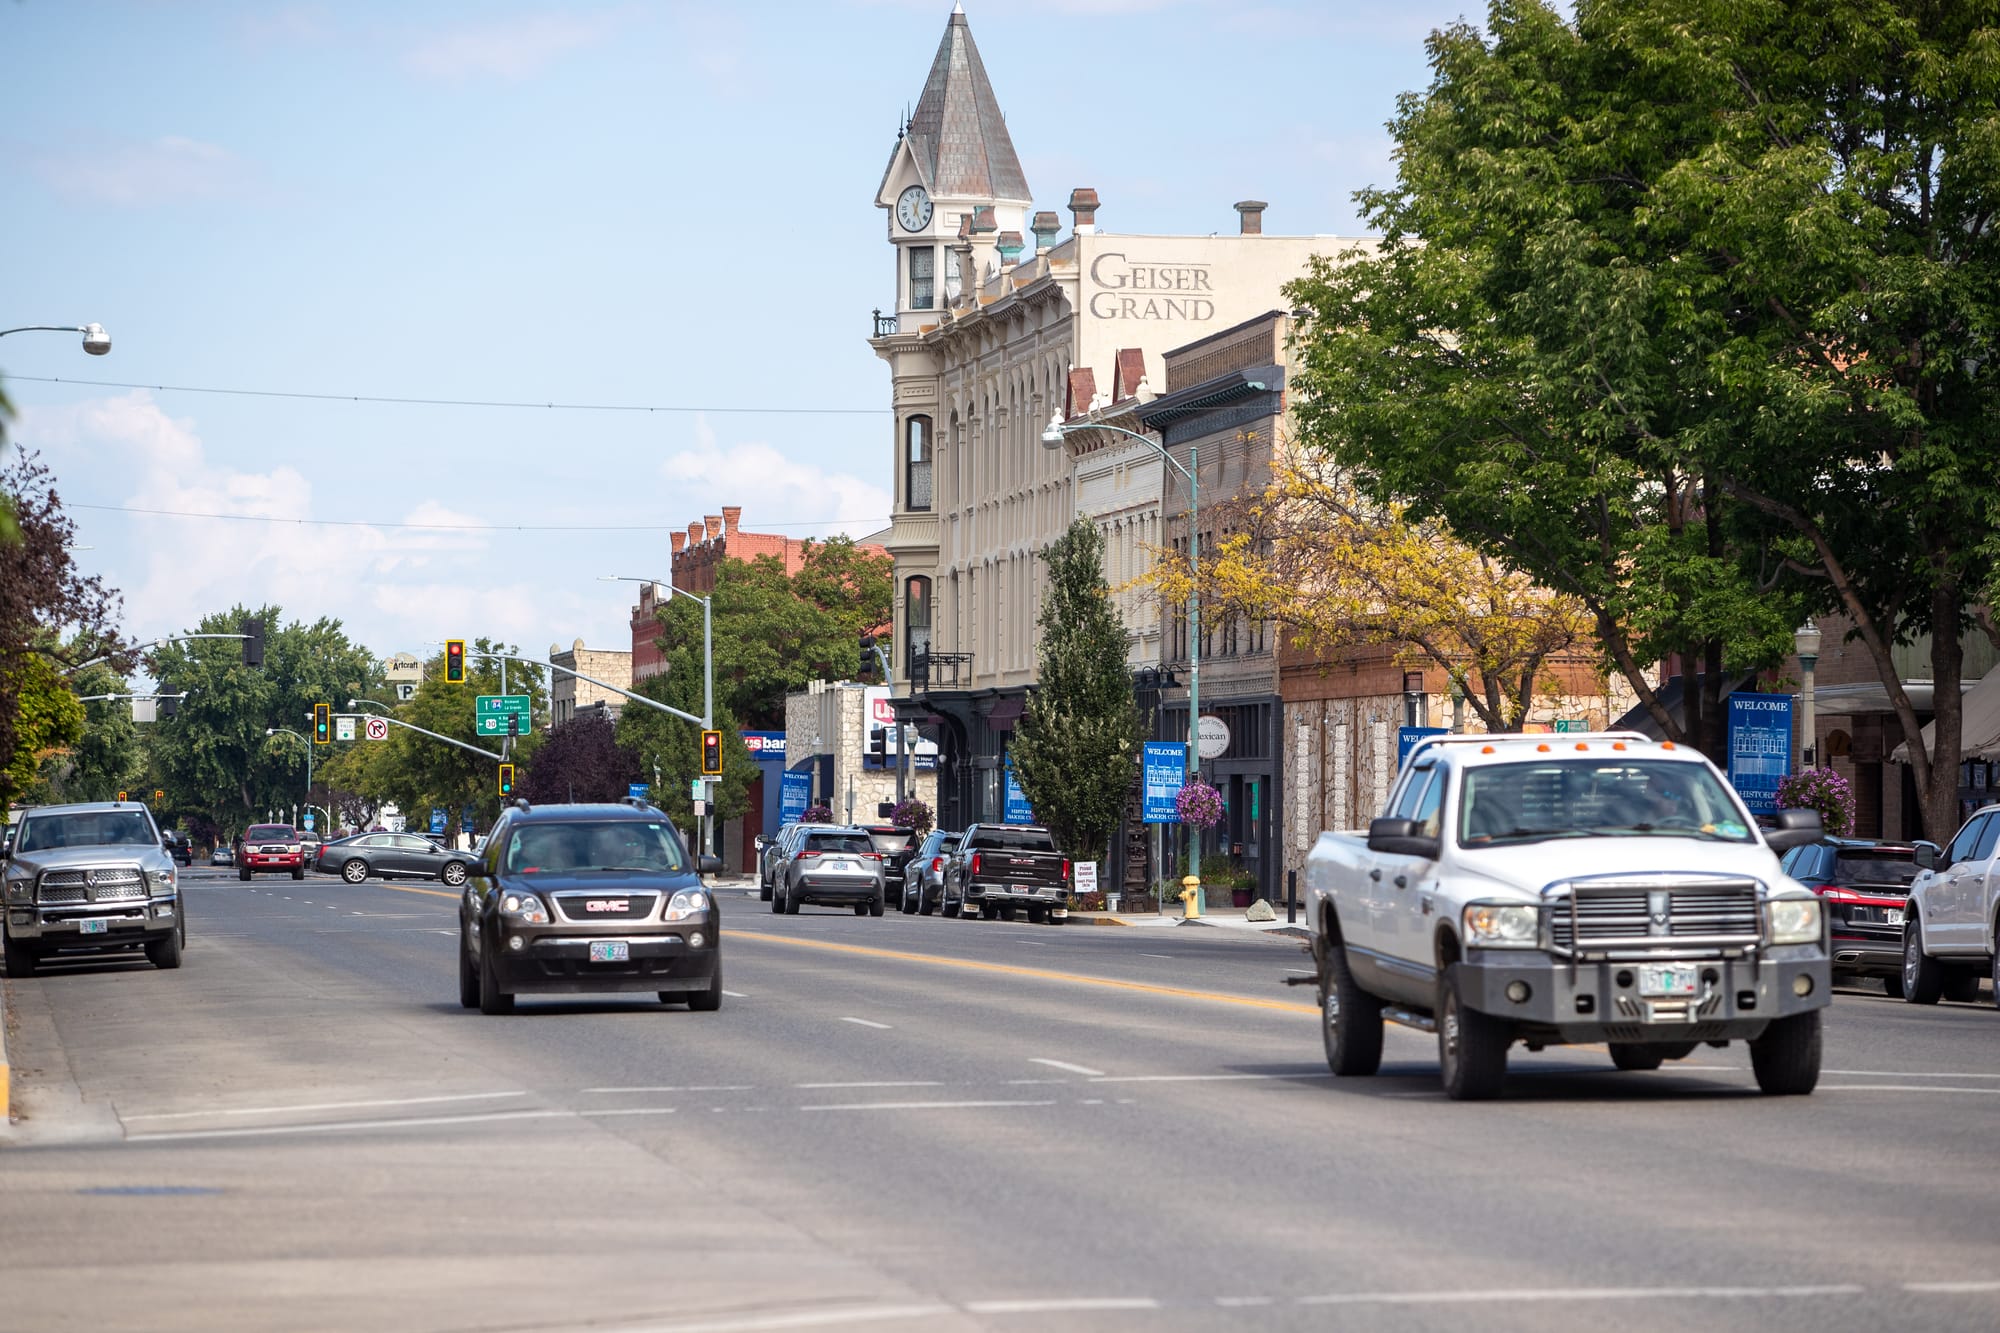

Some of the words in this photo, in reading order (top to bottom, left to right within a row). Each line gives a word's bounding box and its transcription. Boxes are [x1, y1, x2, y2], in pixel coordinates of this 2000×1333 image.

[1090, 252, 1215, 290] GEISER
[1089, 291, 1215, 321] GRAND
[393, 661, 418, 671] Artcraft
[1734, 700, 1788, 712] WELCOME
[487, 720, 496, 728] 30
[1198, 732, 1226, 741] exican
[1147, 748, 1183, 757] WELCOME
[586, 900, 629, 912] GMC
